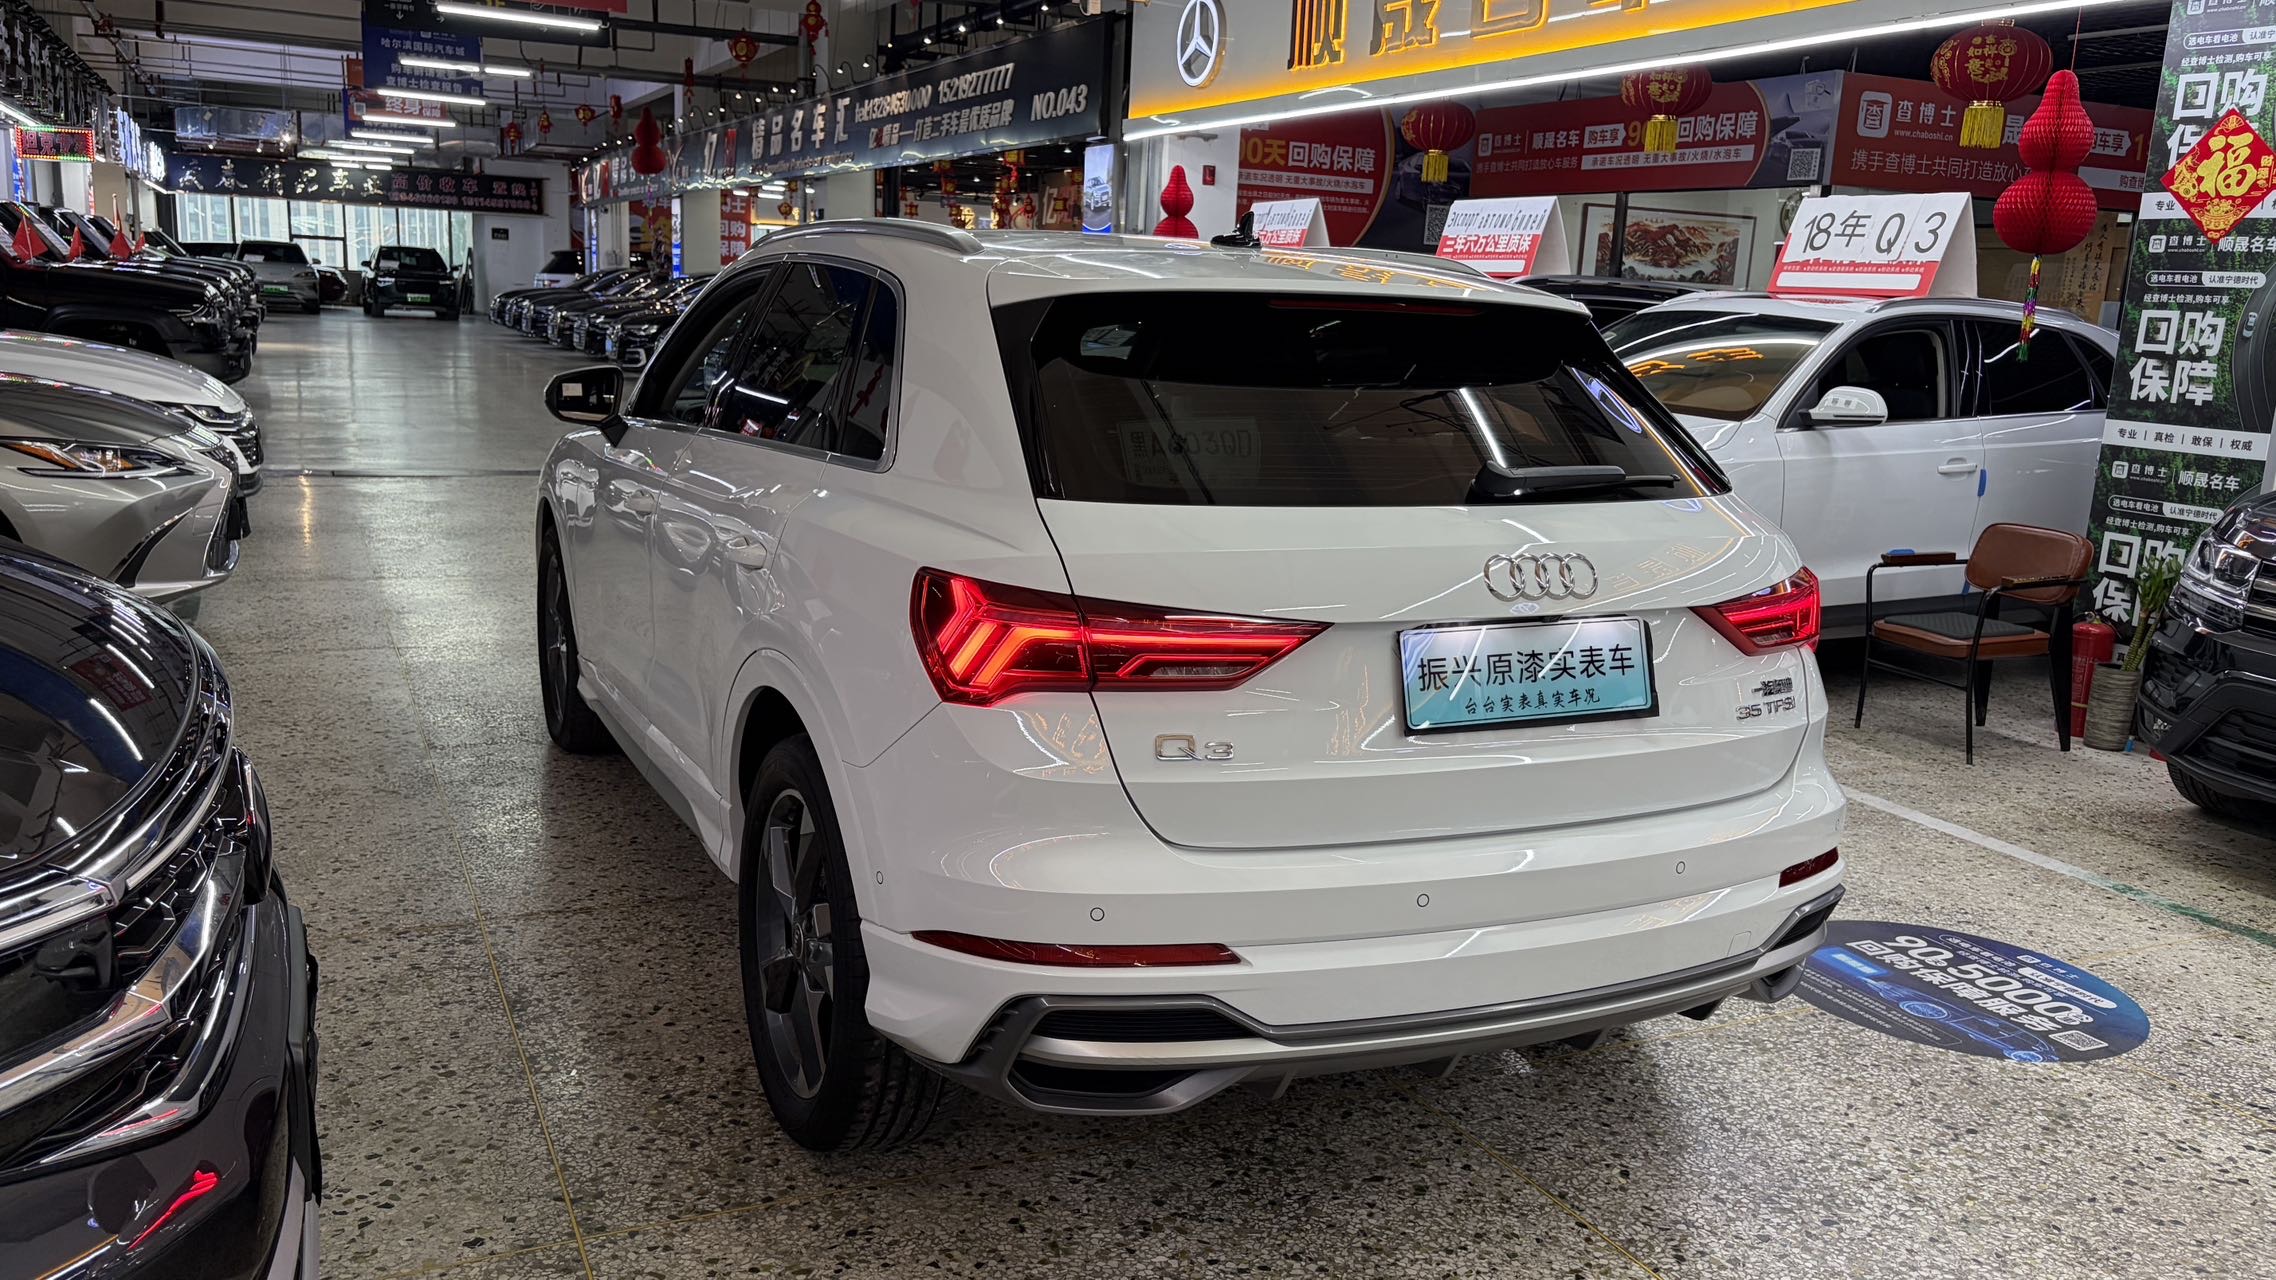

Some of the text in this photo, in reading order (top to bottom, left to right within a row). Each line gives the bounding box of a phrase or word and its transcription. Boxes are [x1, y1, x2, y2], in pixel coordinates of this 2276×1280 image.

[2188, 33, 2239, 46] 选电车看电池
[1030, 83, 1088, 122] NO.043
[2173, 69, 2268, 120] 回购
[1896, 100, 1958, 127] 查博士
[751, 98, 850, 160] 精品名车汇
[1532, 130, 1580, 150] 顺晟名车
[1587, 128, 1620, 146] 购车享
[1677, 110, 1759, 144] 回购保障
[1894, 128, 1954, 142] www.chaboshi.cn
[2197, 132, 2258, 198] 福
[2155, 200, 2176, 211] 专业
[1442, 234, 1532, 254] 三年六万公里质保
[2169, 235, 2276, 253] 查博士 顺晟名车
[2150, 273, 2259, 286] 选电车看电池 认准宁德时代
[2143, 293, 2231, 306] 经查博士检测,购车可享
[2134, 309, 2227, 357] 回购
[2129, 356, 2218, 406] 保障
[2118, 427, 2254, 452] 专业 真检 敢保 权威
[2131, 463, 2241, 493] 查博士 顺晟名车
[2112, 498, 2218, 521] 选电车看电池 认准宁德时代
[2105, 515, 2191, 537] 经查博士检测,购车可享
[1418, 643, 1636, 693] 振兴原漆实表车
[1464, 686, 1601, 716] 台台实表真实车况
[1736, 695, 1796, 721] 35 TFSI
[1155, 734, 1234, 761] Q3
[1846, 940, 2063, 1033] 回购保障服务
